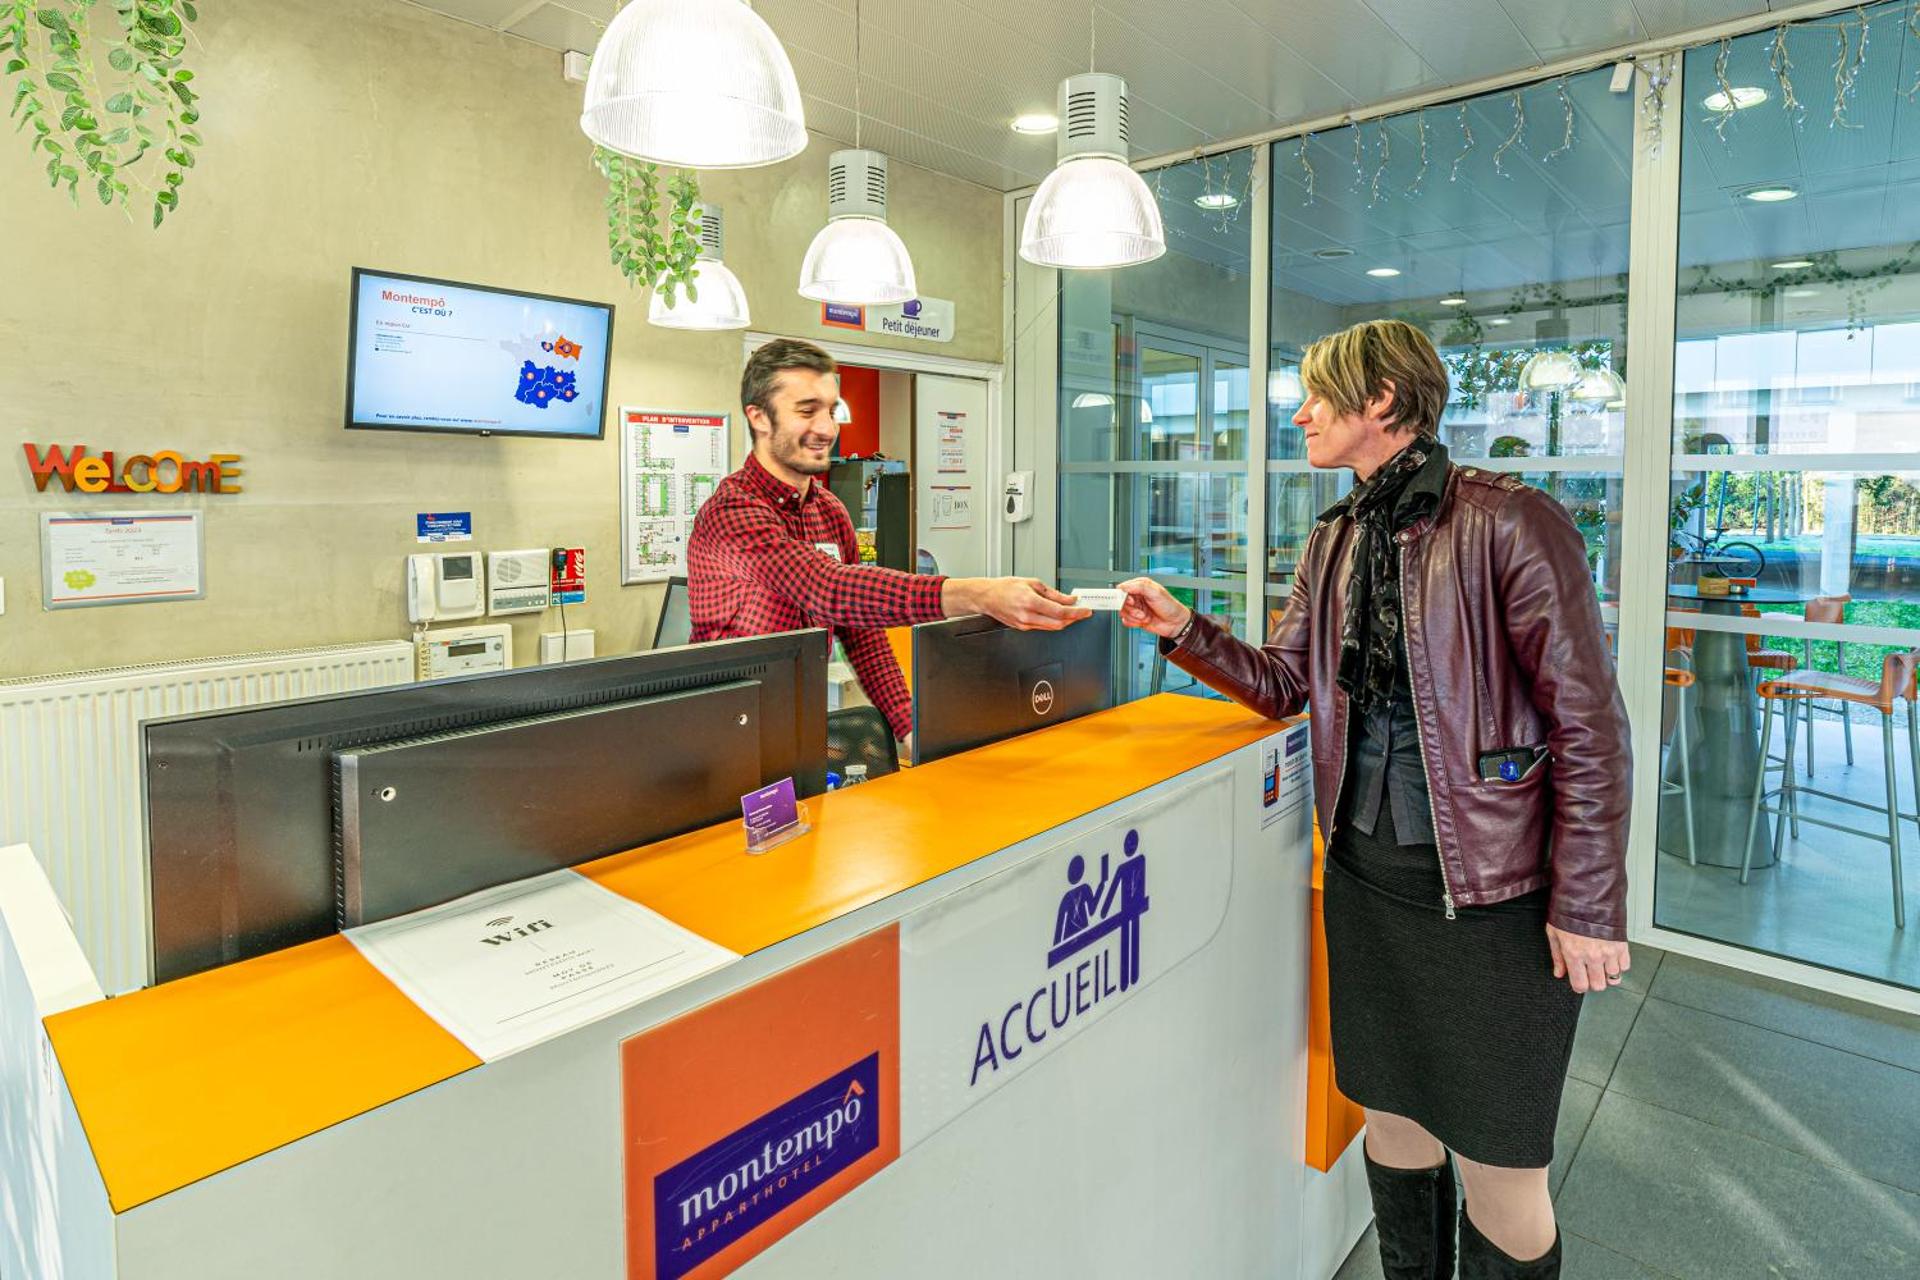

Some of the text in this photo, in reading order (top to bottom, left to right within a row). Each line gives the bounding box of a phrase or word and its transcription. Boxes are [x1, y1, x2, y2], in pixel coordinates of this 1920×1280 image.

[382, 290, 446, 308] Montempô
[411, 306, 432, 315] C'EST
[882, 317, 940, 338] Petit déjeuner
[642, 414, 658, 422] PLAN
[1035, 692, 1051, 704] DELL
[480, 919, 554, 945] Wifi
[970, 949, 1117, 1086] ACCUEIL
[679, 1078, 866, 1226] montempô
[681, 1155, 823, 1251] APPARTHOTEL
